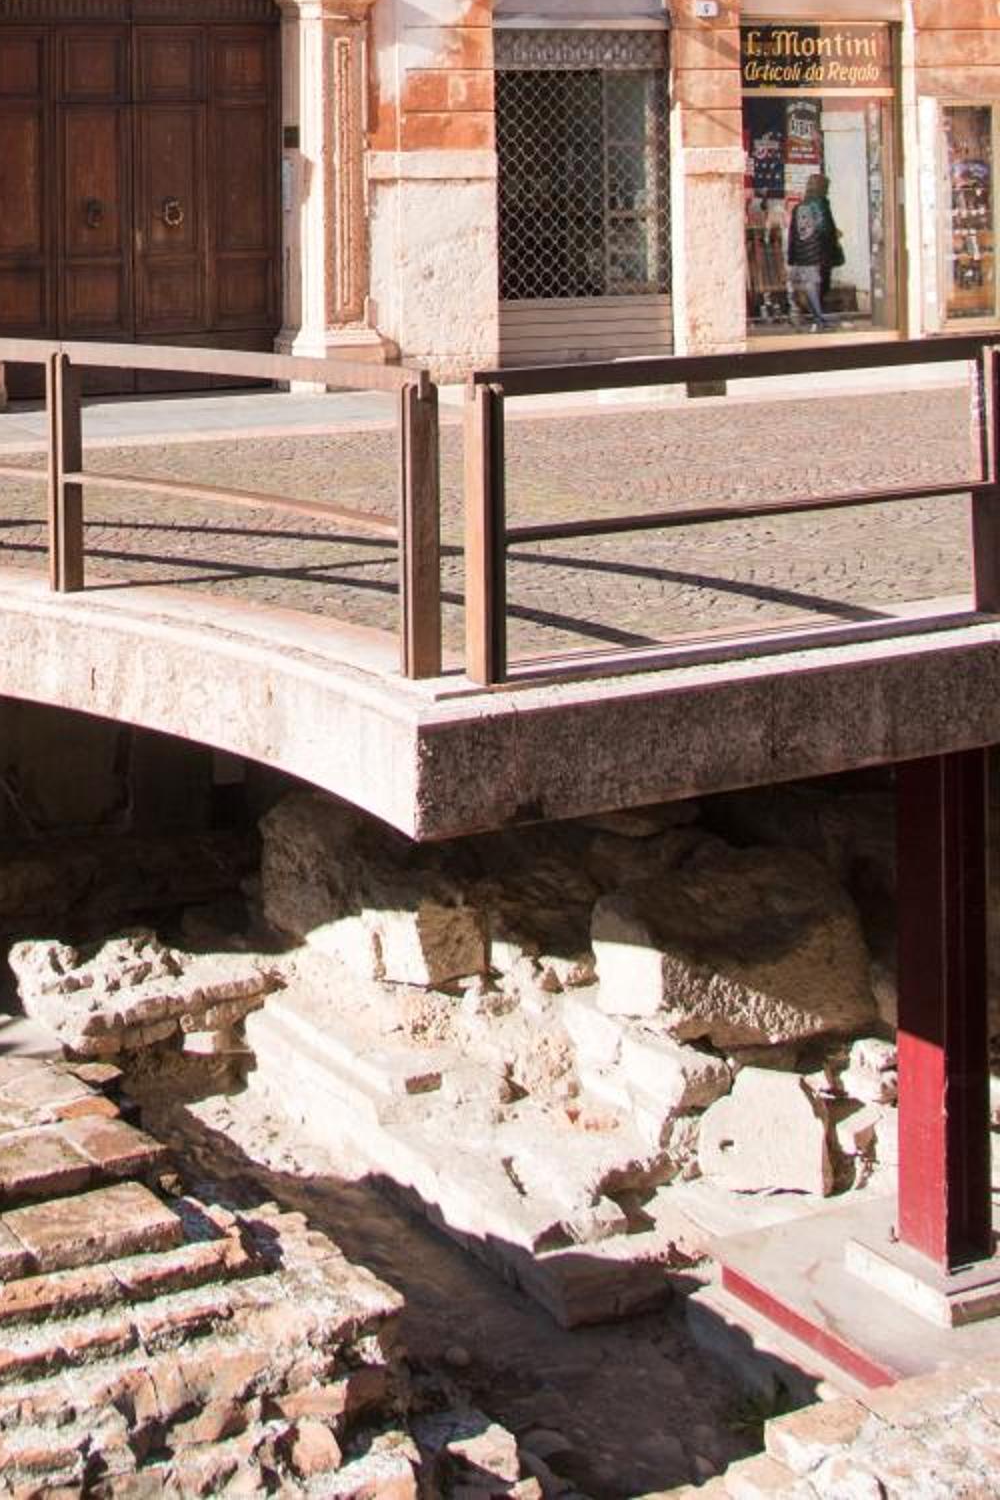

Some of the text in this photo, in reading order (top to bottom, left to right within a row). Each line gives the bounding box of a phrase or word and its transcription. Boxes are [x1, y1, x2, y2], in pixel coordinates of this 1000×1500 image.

[771, 30, 877, 57] Montini
[745, 61, 879, 86] Articoli da Regalo
